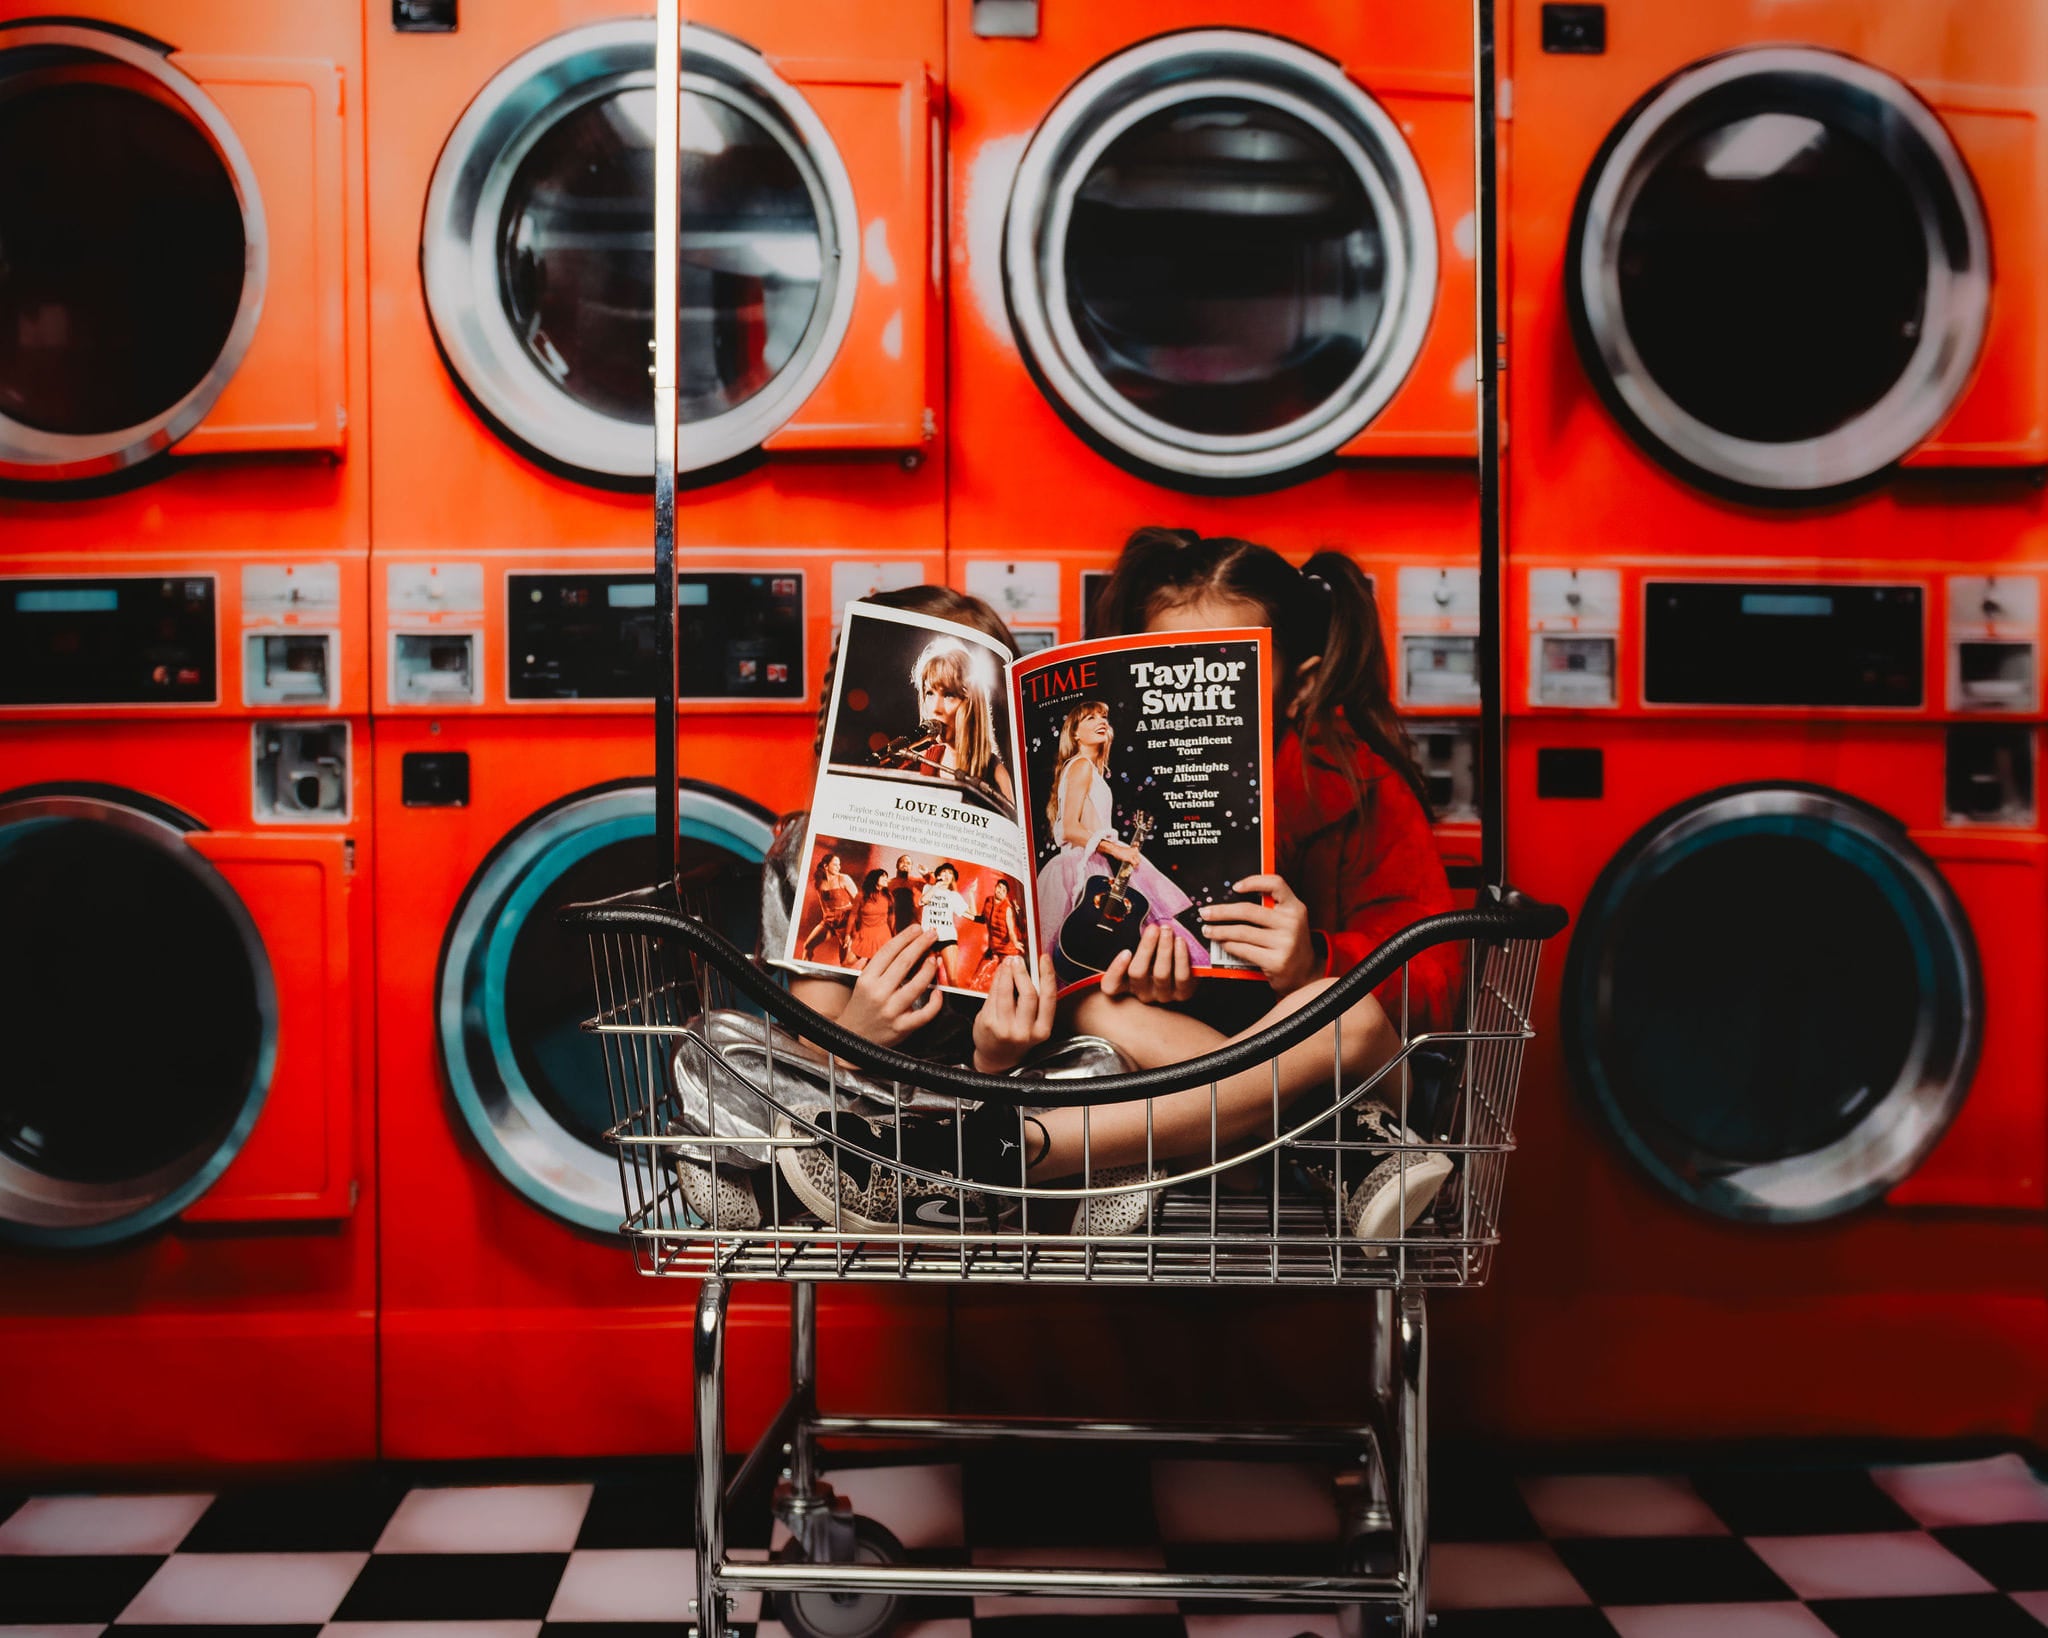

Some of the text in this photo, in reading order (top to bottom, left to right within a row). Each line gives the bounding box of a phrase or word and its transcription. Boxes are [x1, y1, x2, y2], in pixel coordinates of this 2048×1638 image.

[1130, 657, 1246, 689] Taylor
[1025, 661, 1098, 703] TIME
[1038, 692, 1083, 708] SPECIAL EDITION
[1142, 684, 1236, 715] Swift
[1136, 714, 1244, 732] A Magical Era
[1147, 736, 1232, 749] Her Magnificent
[1177, 747, 1203, 756] Tour
[1152, 762, 1229, 775] The Midnights
[1173, 773, 1209, 783] Album
[1163, 789, 1219, 800] The Taylor
[1168, 800, 1215, 809] Versions
[894, 797, 990, 828] LOVE STORY
[1173, 821, 1212, 830] Her Fans
[1163, 830, 1181, 838] and
[1182, 829, 1197, 837] the
[1167, 836, 1218, 846] She's Lifted
